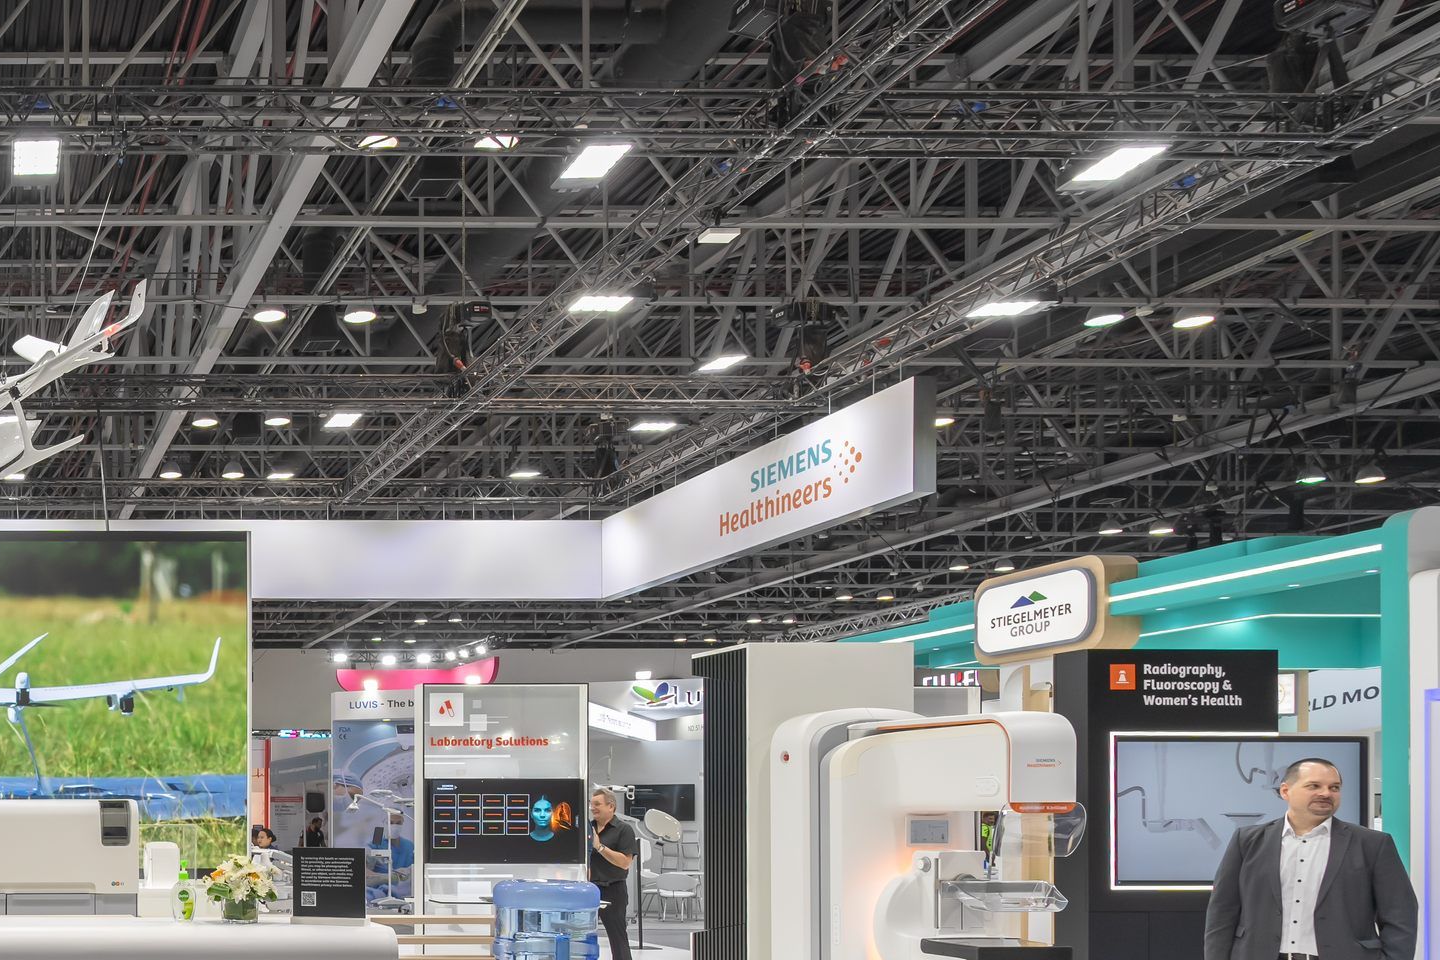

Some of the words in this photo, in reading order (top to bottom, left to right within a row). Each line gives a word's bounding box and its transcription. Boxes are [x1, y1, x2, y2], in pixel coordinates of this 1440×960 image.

[750, 439, 832, 493] SIEMENS
[719, 477, 832, 537] Healthineers
[990, 603, 1072, 629] STIEGELMEYER
[1010, 620, 1051, 637] GROUP
[1143, 663, 1226, 678] Radiography,
[1143, 679, 1220, 694] Fluoroscopy
[1222, 680, 1232, 690] &
[349, 700, 378, 709] LUVIS
[387, 700, 406, 708] The
[1201, 695, 1242, 706] Health
[1308, 695, 1337, 712] LD
[1342, 686, 1380, 705] MO
[431, 737, 493, 749] Laboratory
[496, 736, 549, 747] Solutions
